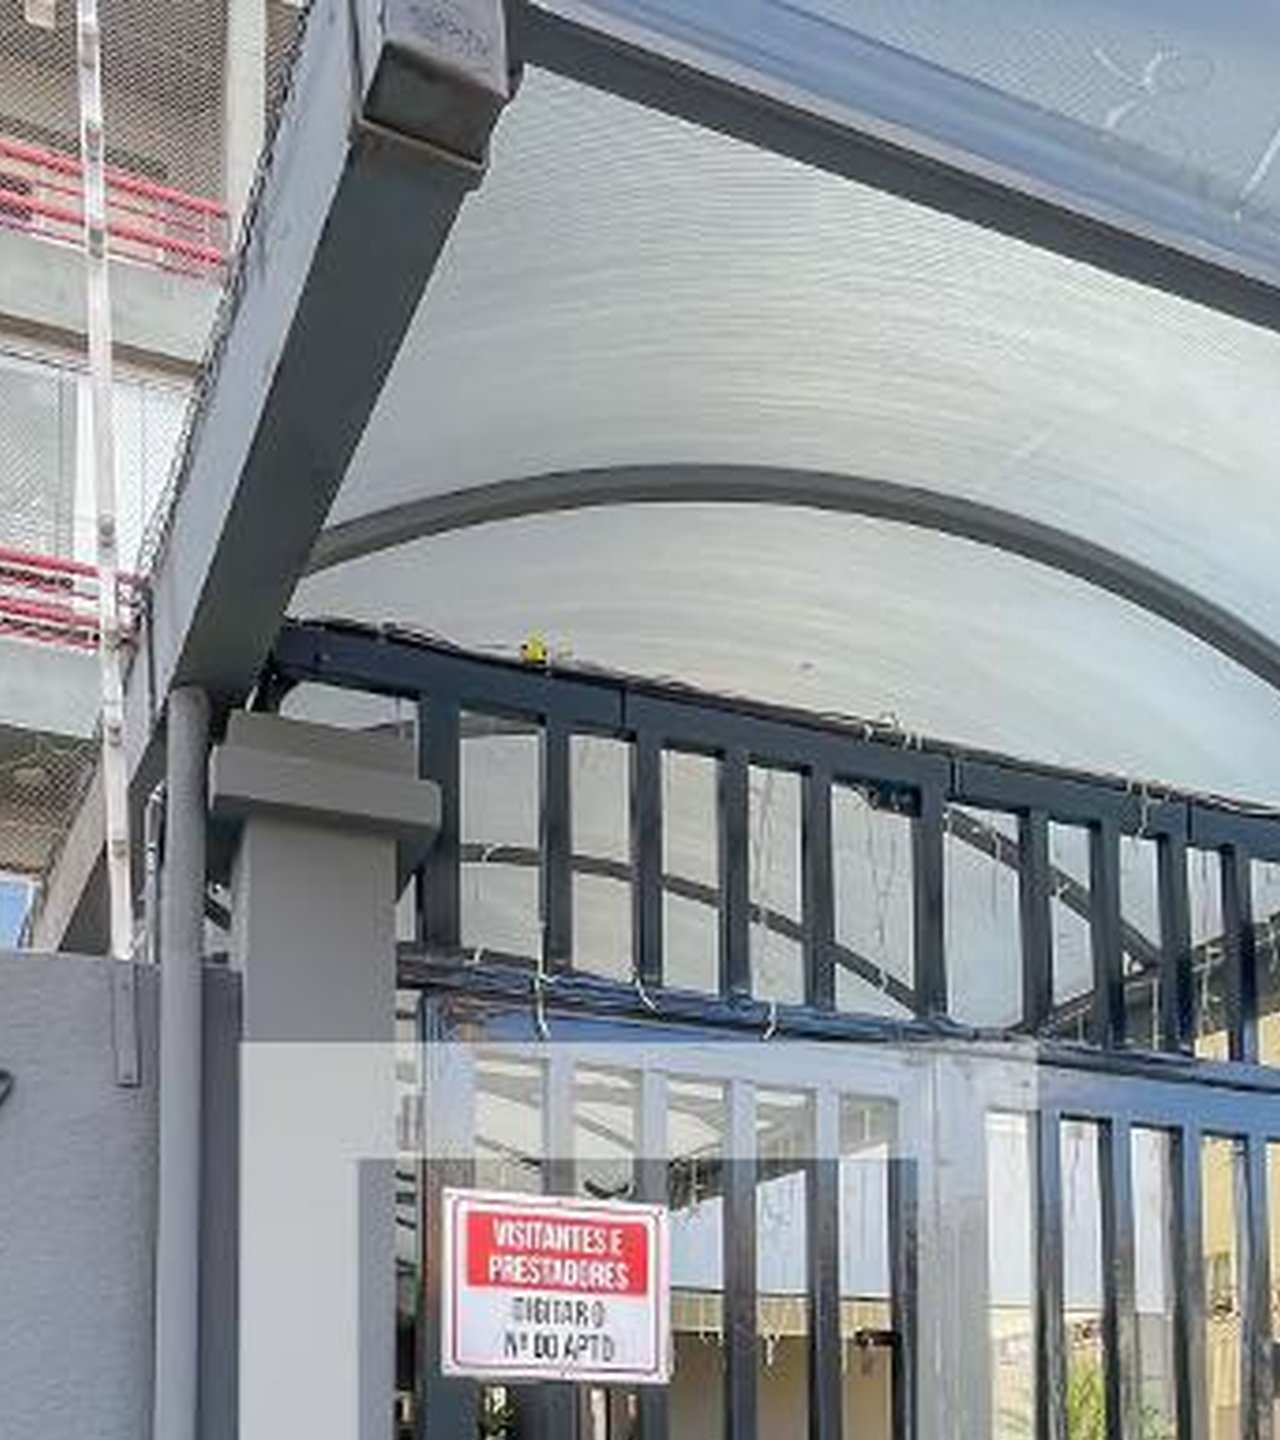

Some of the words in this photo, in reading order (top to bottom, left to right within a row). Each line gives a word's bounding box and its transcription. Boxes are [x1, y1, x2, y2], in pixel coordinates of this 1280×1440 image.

[493, 1217, 608, 1254] VISITANTES
[610, 1229, 624, 1256] E
[489, 1255, 630, 1291] PRESTADORES
